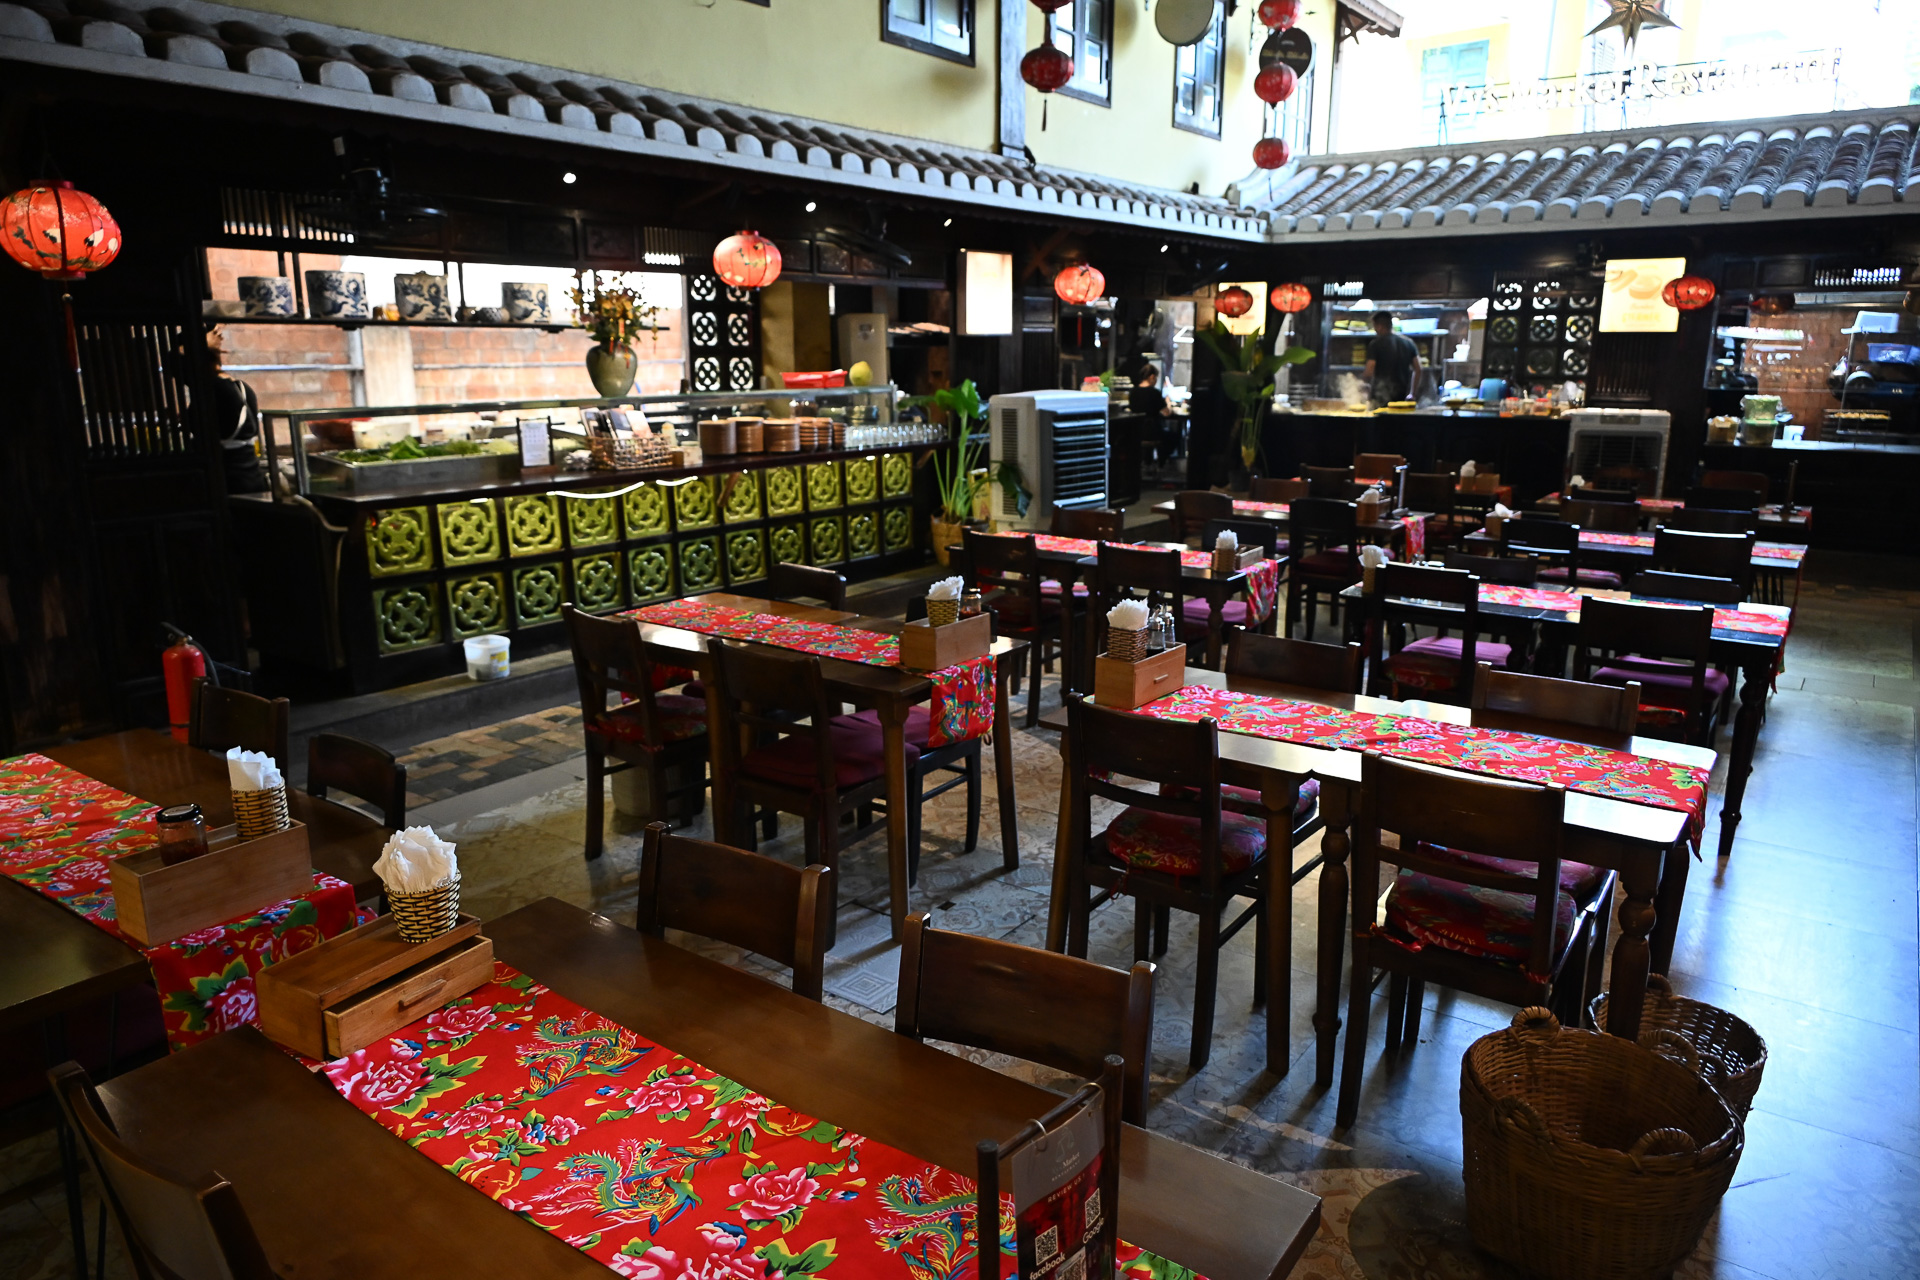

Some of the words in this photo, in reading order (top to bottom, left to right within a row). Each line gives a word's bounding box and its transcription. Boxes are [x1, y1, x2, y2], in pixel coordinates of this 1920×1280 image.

[1441, 77, 1498, 120] Vy's
[1509, 70, 1629, 112] Market
[1629, 47, 1841, 99] Restaurant
[1047, 1183, 1073, 1204] REVIEW
[1082, 1217, 1105, 1245] Google
[1029, 1252, 1067, 1280] facebook
